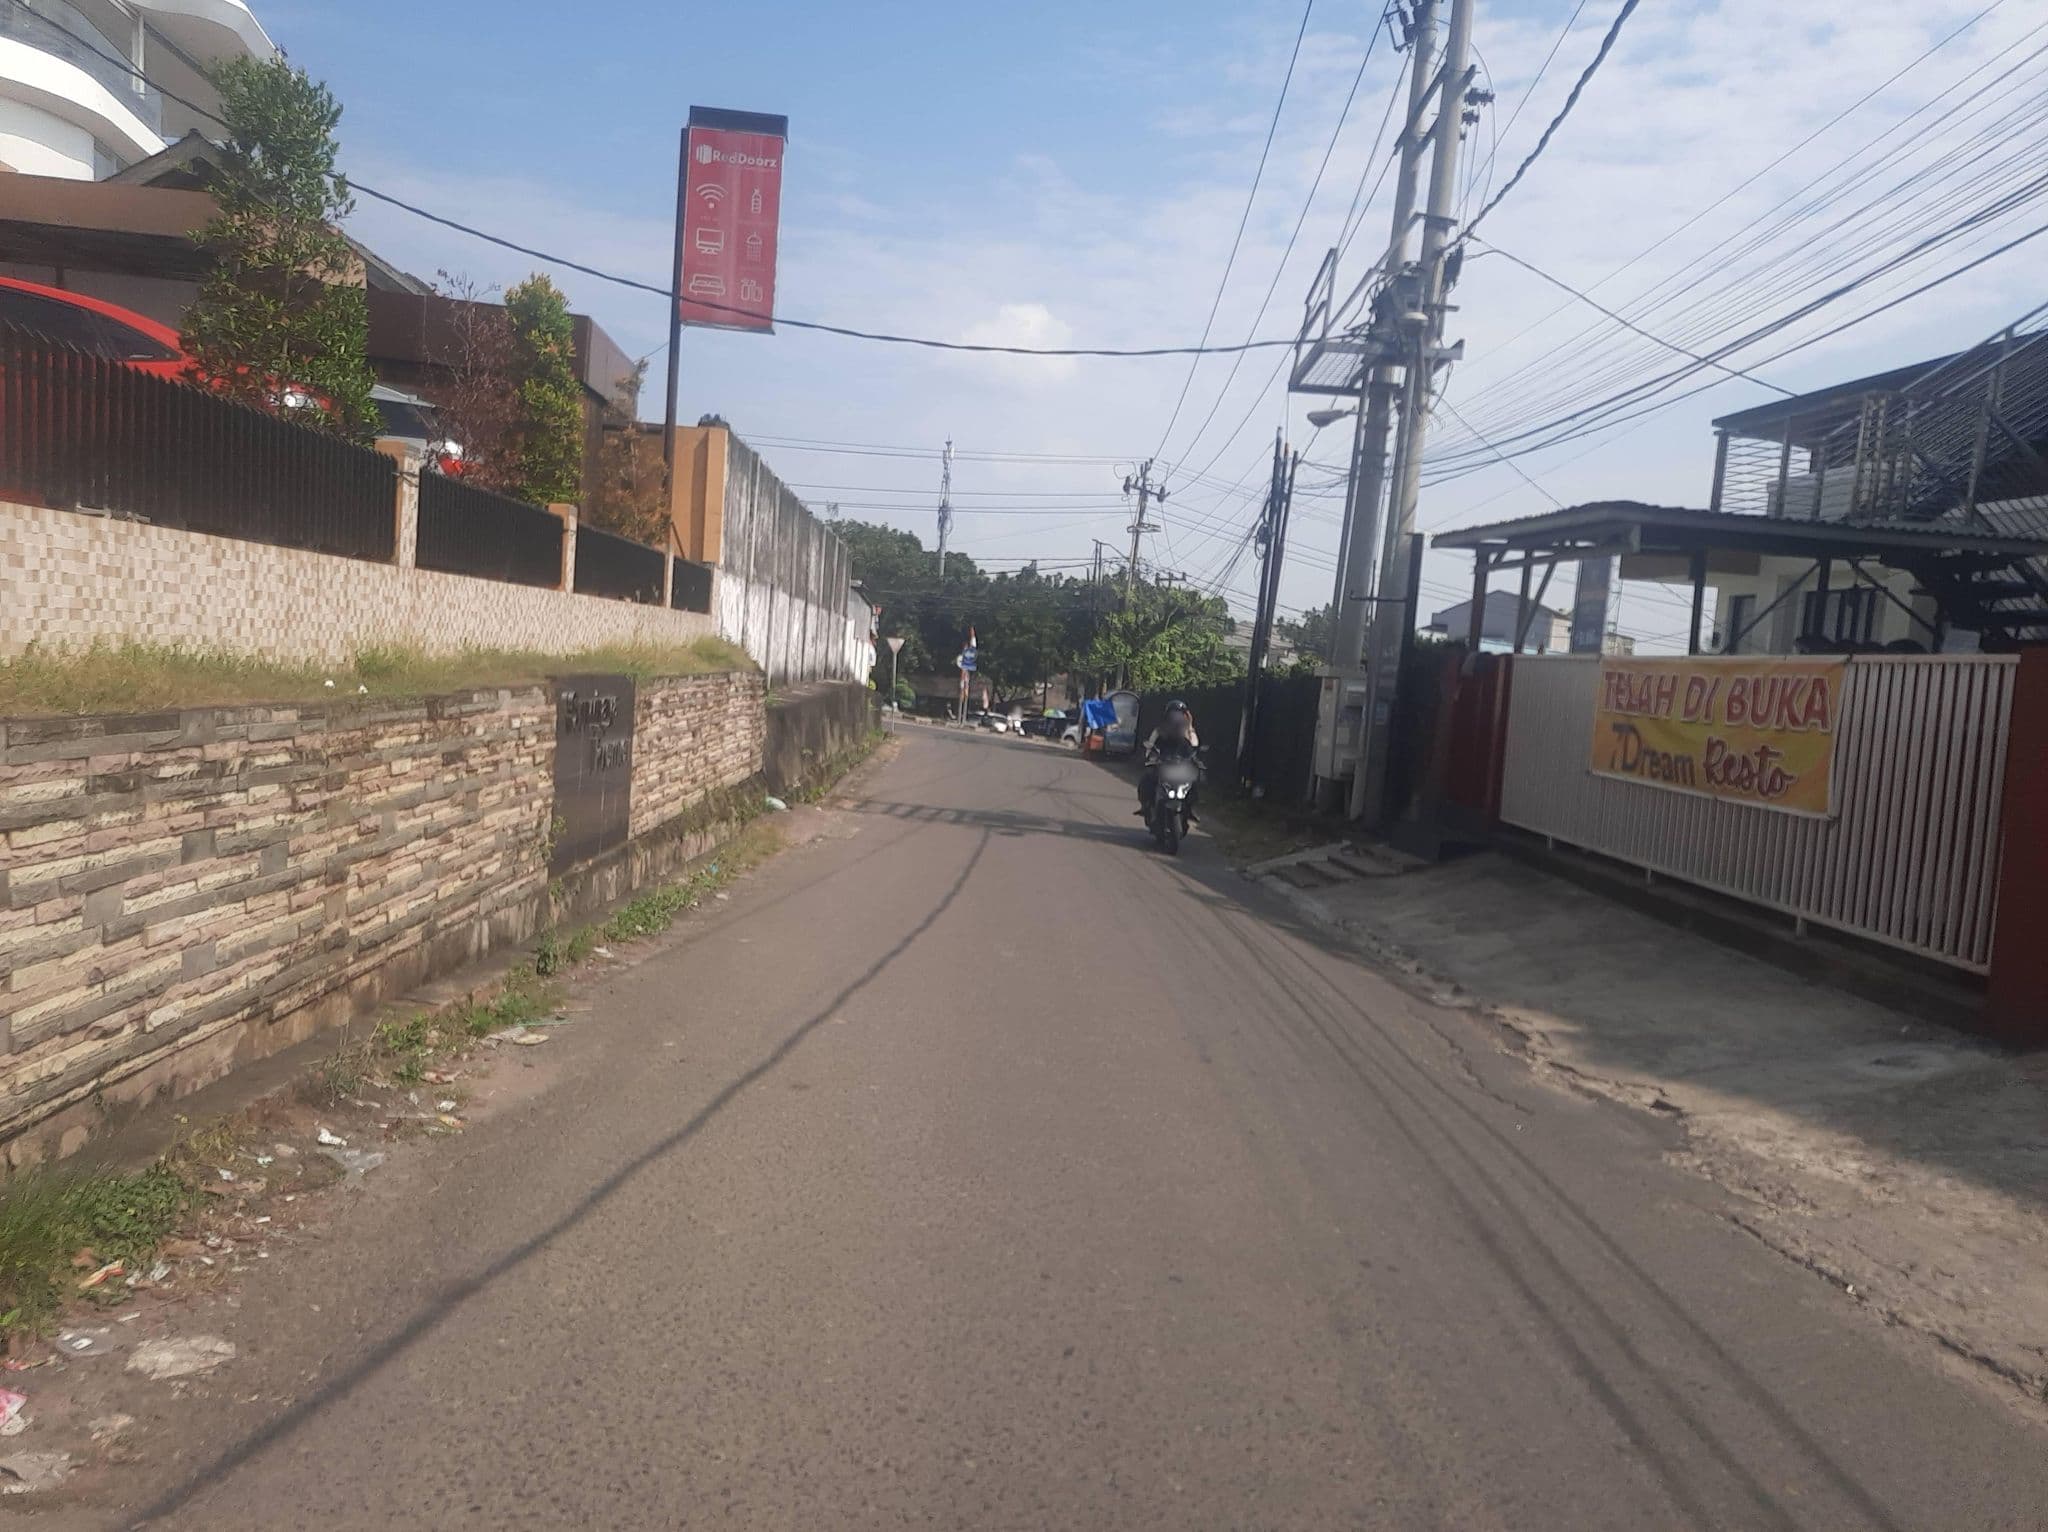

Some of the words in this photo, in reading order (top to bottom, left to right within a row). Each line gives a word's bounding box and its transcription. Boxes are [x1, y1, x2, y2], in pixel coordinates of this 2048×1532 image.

[1604, 671, 1679, 717] TELAH
[1682, 676, 1721, 721] DI
[1726, 676, 1831, 731] BUKA
[1611, 722, 1696, 785] Dream
[1703, 735, 1796, 797] Resto
